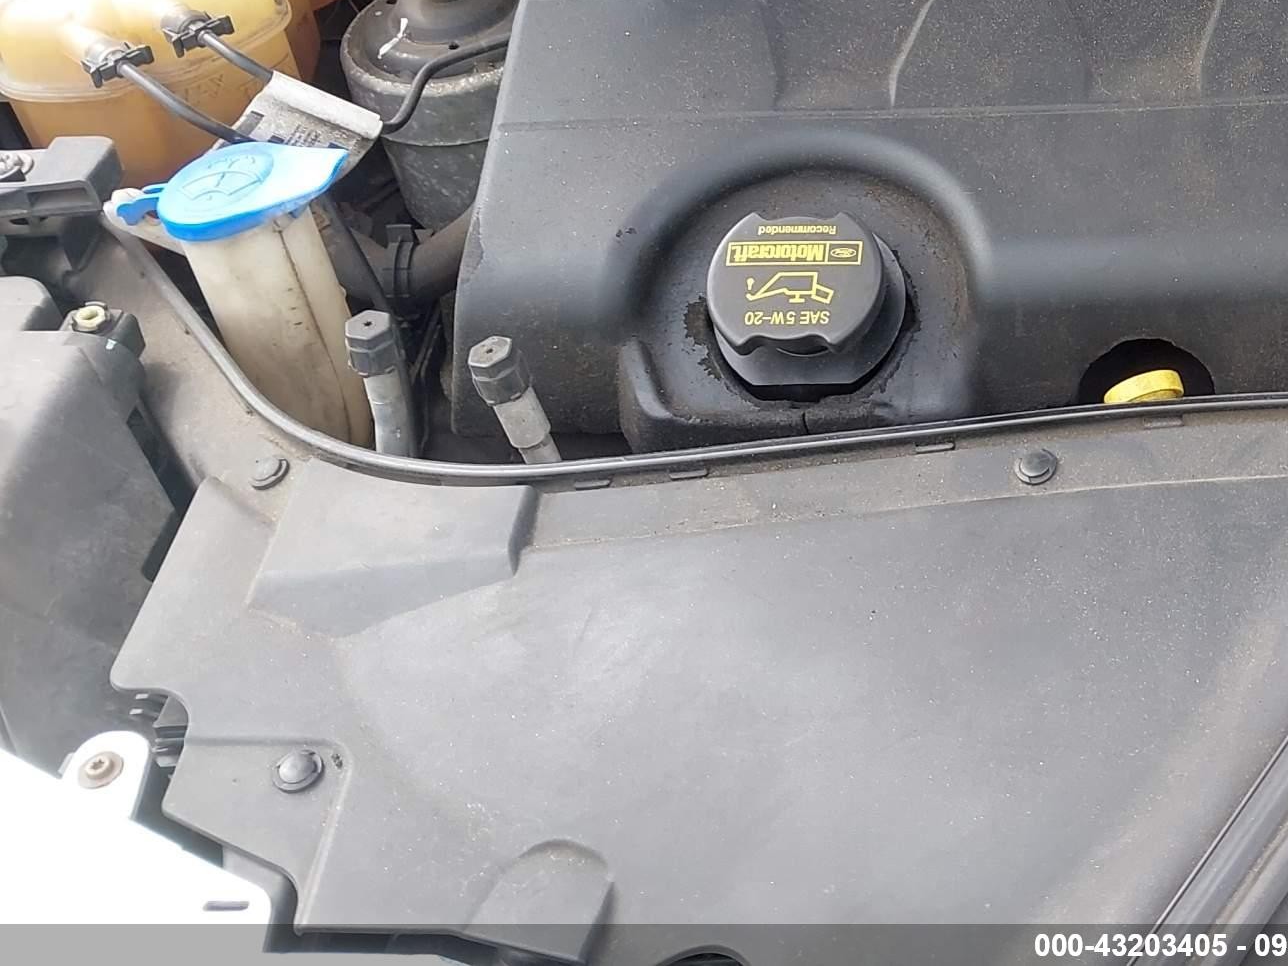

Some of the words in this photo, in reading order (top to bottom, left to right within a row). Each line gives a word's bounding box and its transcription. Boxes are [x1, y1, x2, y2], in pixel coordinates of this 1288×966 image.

[757, 225, 837, 235] Recommended
[731, 244, 825, 262] Motorcraft
[744, 311, 795, 325] 5W-20
[800, 311, 830, 325] SAE
